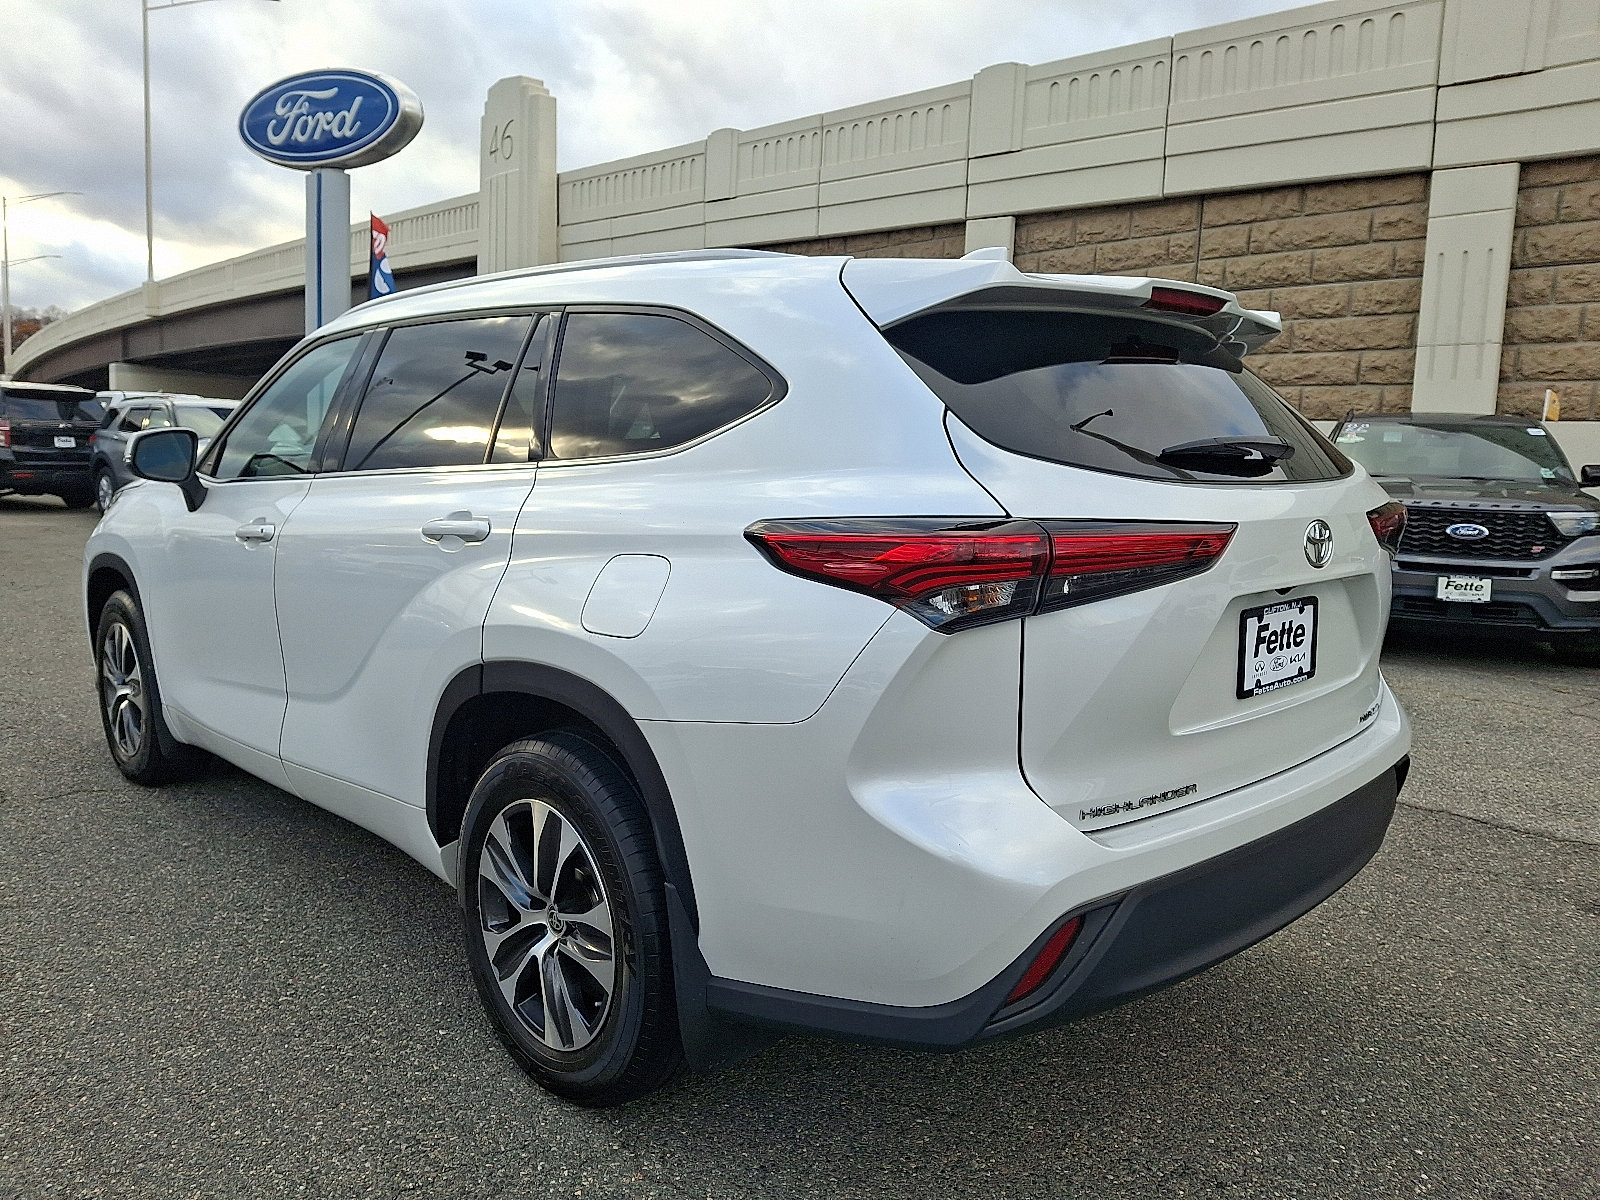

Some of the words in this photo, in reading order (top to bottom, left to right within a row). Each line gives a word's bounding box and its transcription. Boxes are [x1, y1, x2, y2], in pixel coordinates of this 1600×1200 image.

[267, 87, 363, 145] Ford
[488, 119, 514, 163] 46
[1444, 580, 1484, 592] Fette
[1253, 619, 1306, 659] Fette
[1253, 674, 1308, 697] FetteAuto.com
[1079, 783, 1198, 821] HIGHLANDER
